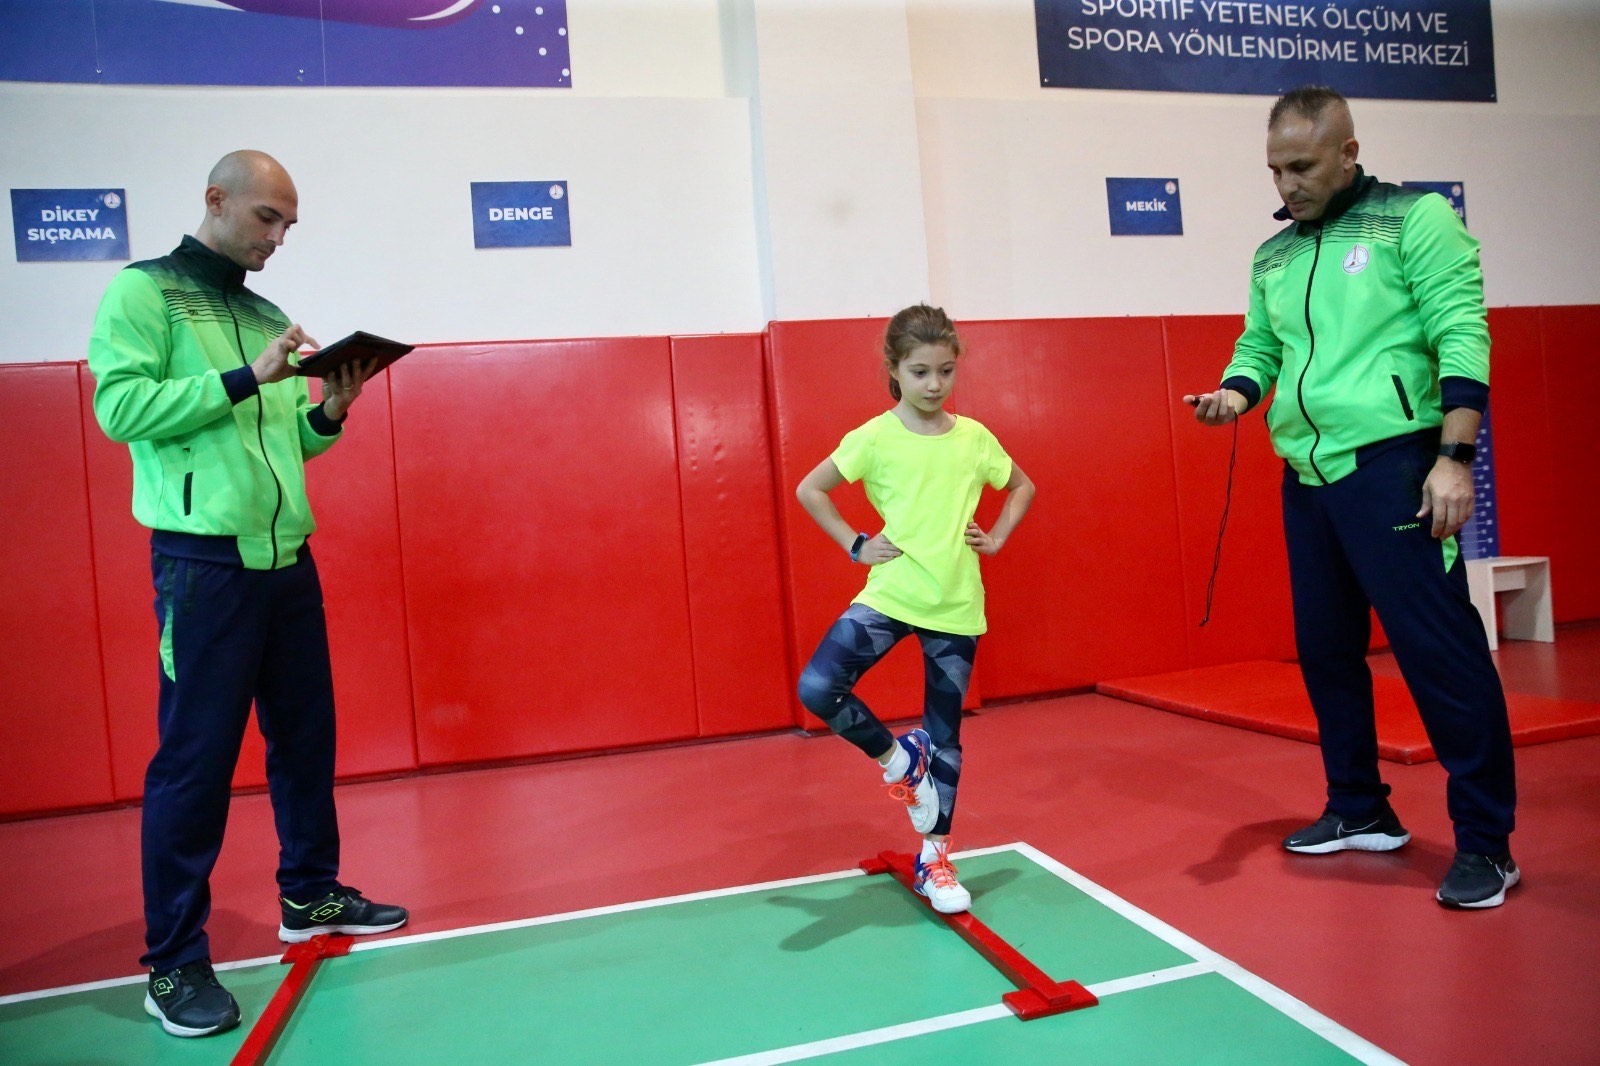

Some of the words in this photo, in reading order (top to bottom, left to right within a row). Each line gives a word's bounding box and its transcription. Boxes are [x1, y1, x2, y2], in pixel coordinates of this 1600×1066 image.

[1200, 1, 1318, 28] YETENEK
[1322, 3, 1411, 36] ÖLÇÜM
[1417, 12, 1449, 33] VE
[1068, 26, 1164, 53] SPORA
[1168, 28, 1358, 62] YÖNLENDİRME
[1365, 41, 1469, 66] MERKEZİ
[41, 205, 100, 222] DİKEY
[1125, 198, 1168, 212] MEKİK
[488, 206, 554, 222] DENGE
[27, 227, 117, 245] SIÇRAMA
[1392, 522, 1420, 532] TRYON
